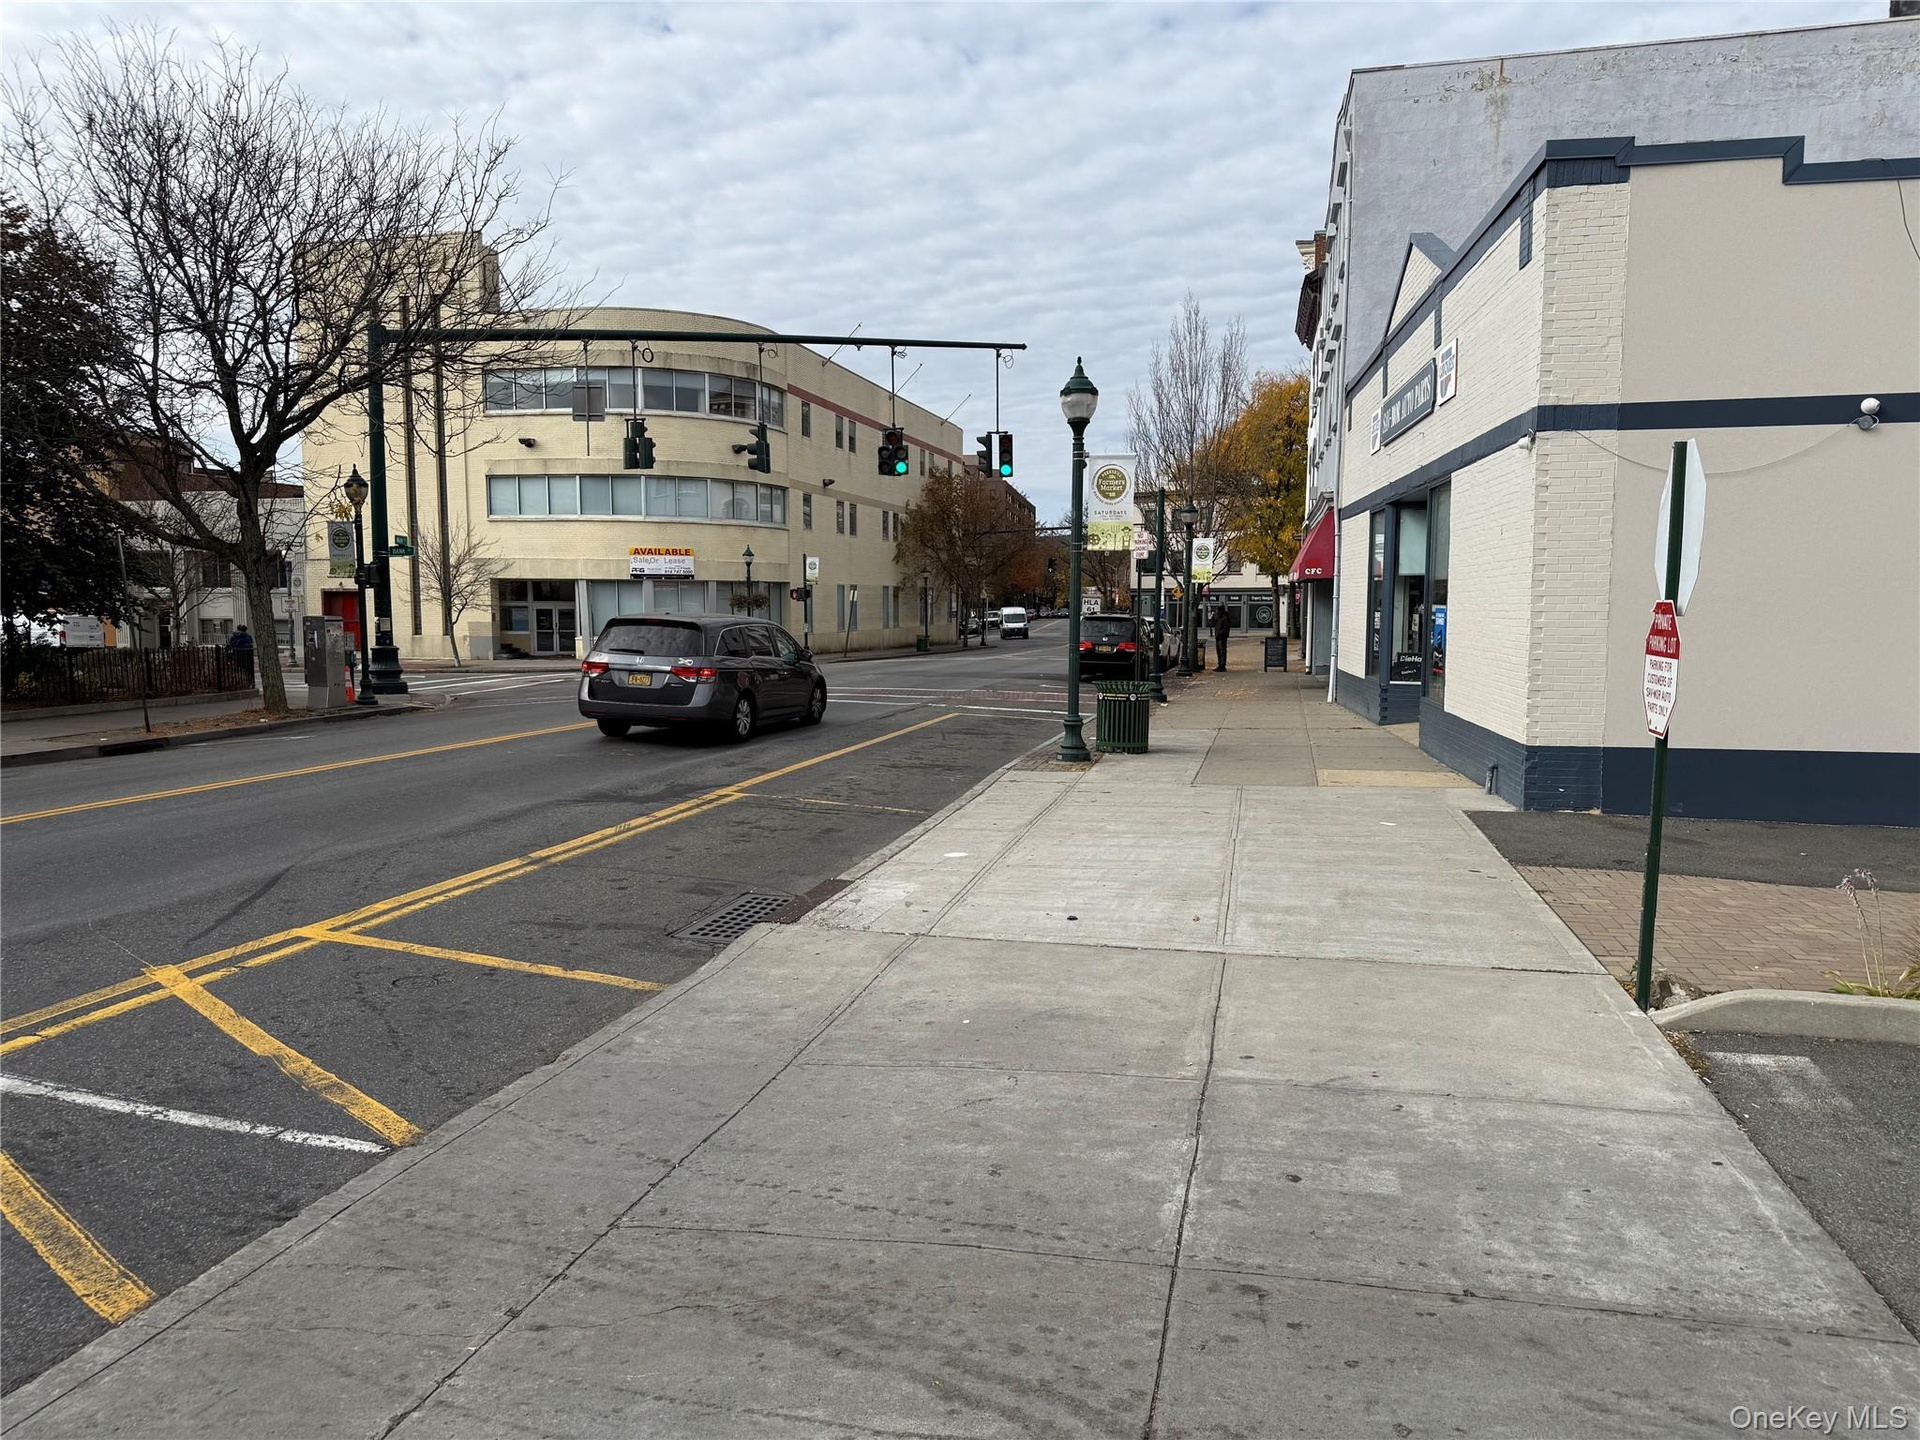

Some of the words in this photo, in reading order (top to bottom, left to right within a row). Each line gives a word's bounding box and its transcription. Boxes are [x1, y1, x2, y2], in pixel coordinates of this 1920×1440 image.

[633, 548, 691, 556] AVAILABLE
[633, 556, 649, 564] Sale
[1304, 567, 1323, 575] CFC
[1655, 614, 1673, 631] PRIVATE
[1648, 634, 1667, 652] PARKING
[1667, 636, 1677, 654] LOT
[1649, 658, 1664, 671] PARKING
[1664, 661, 1673, 672] FOR
[1647, 672, 1667, 687] CUSTOMERS
[1667, 677, 1673, 688] OF
[1661, 690, 1672, 703] AUTO
[1647, 701, 1658, 714] PARTS
[1658, 704, 1669, 717] ONLY
